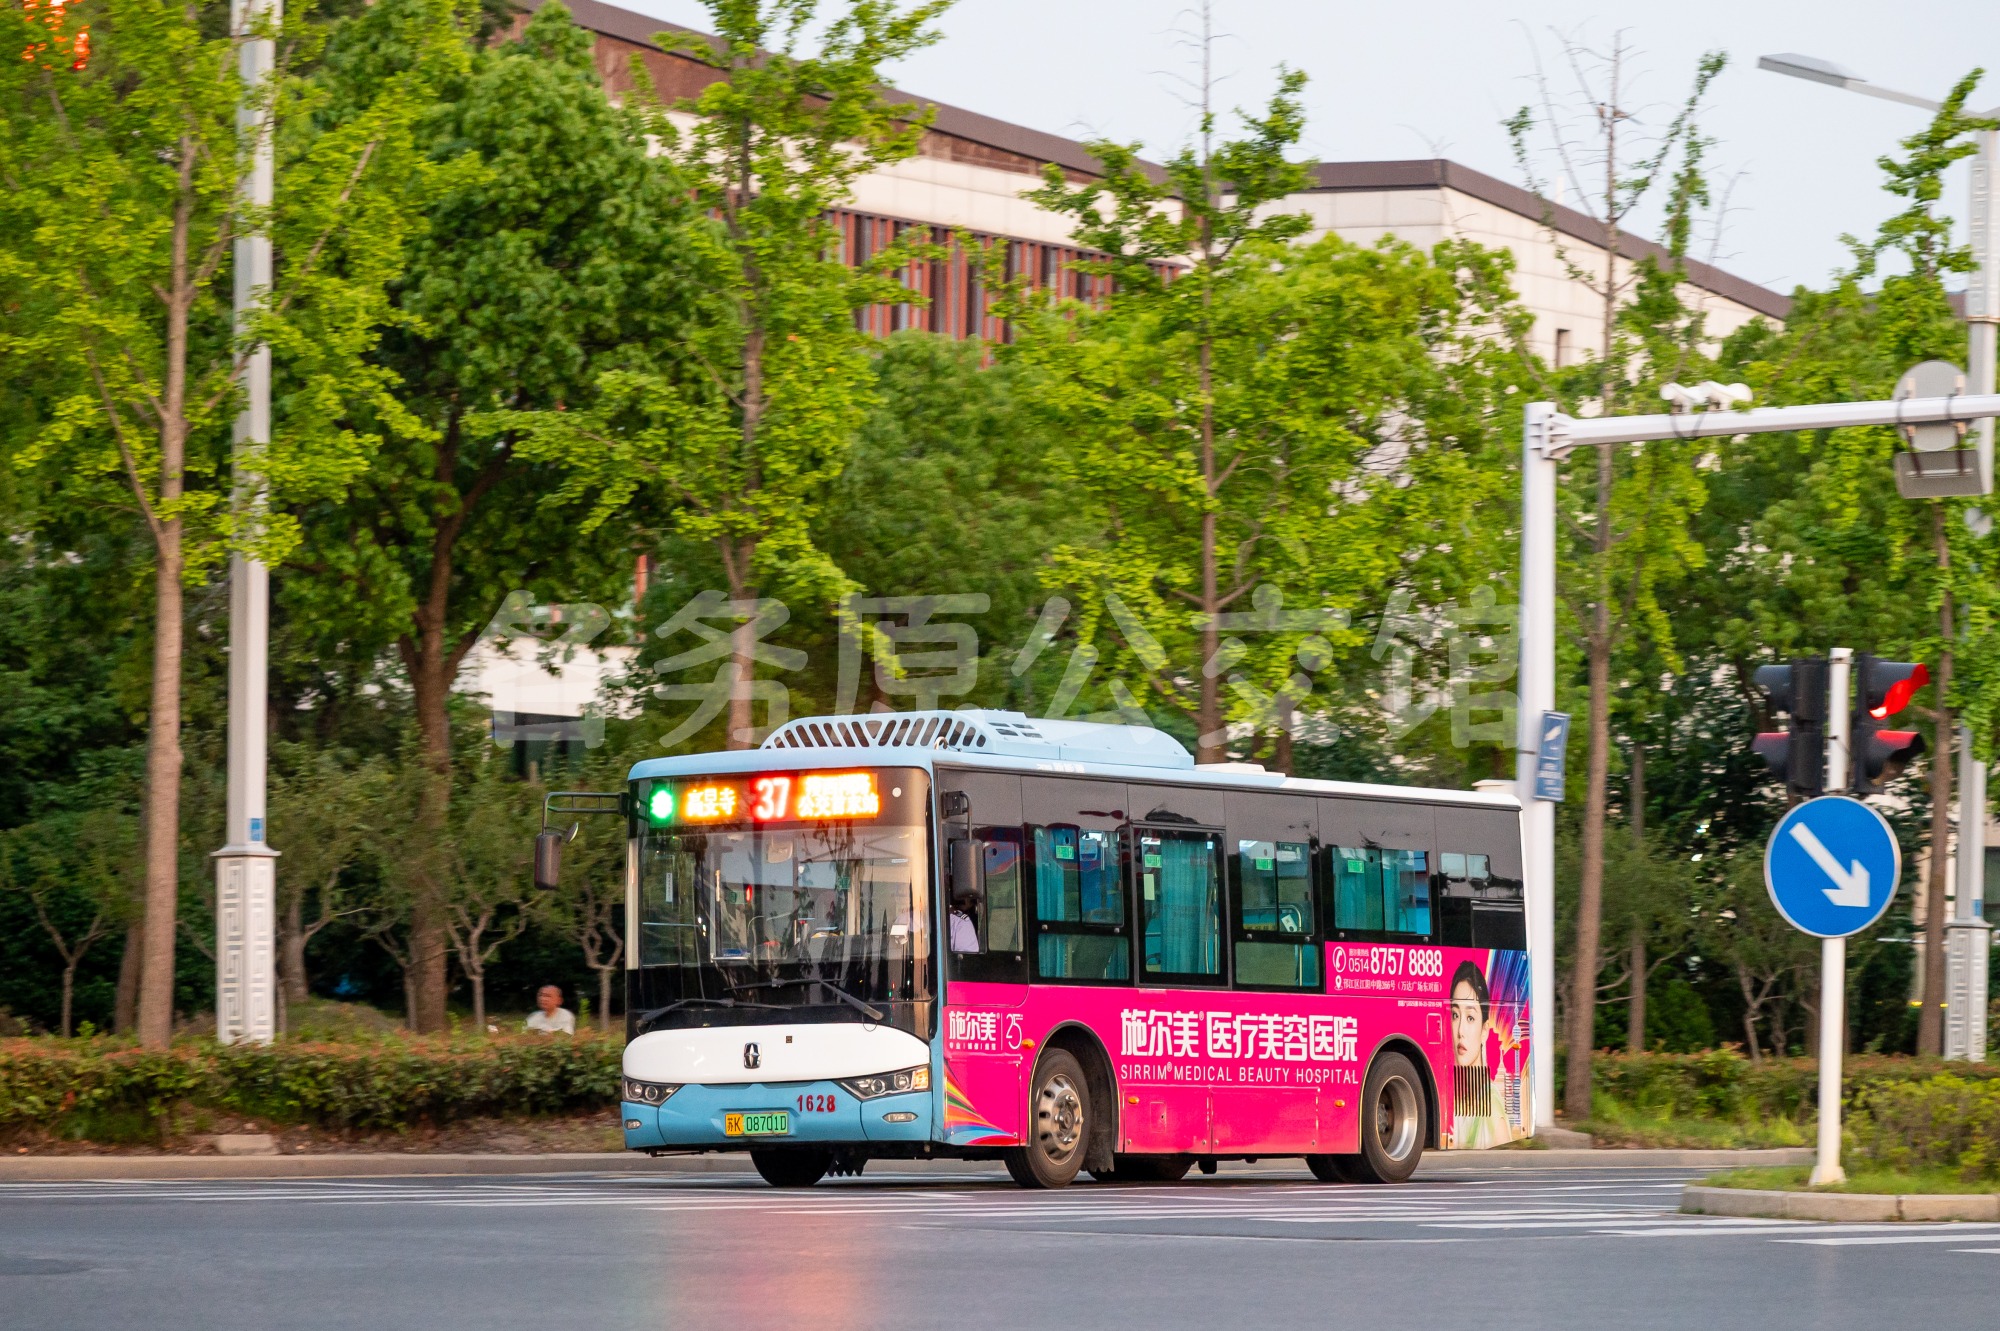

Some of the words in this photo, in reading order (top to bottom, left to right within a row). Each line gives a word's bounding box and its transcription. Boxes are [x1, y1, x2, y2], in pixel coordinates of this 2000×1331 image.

[756, 778, 790, 819] 37
[1348, 957, 1369, 973] 0514
[1370, 946, 1405, 976] 8757
[1408, 948, 1443, 977] 8888
[1174, 1065, 1233, 1082] MEDICAL
[1239, 1066, 1290, 1083] BEAUTY
[1296, 1068, 1359, 1085] HOSPITAL
[797, 1094, 836, 1113] 1628
